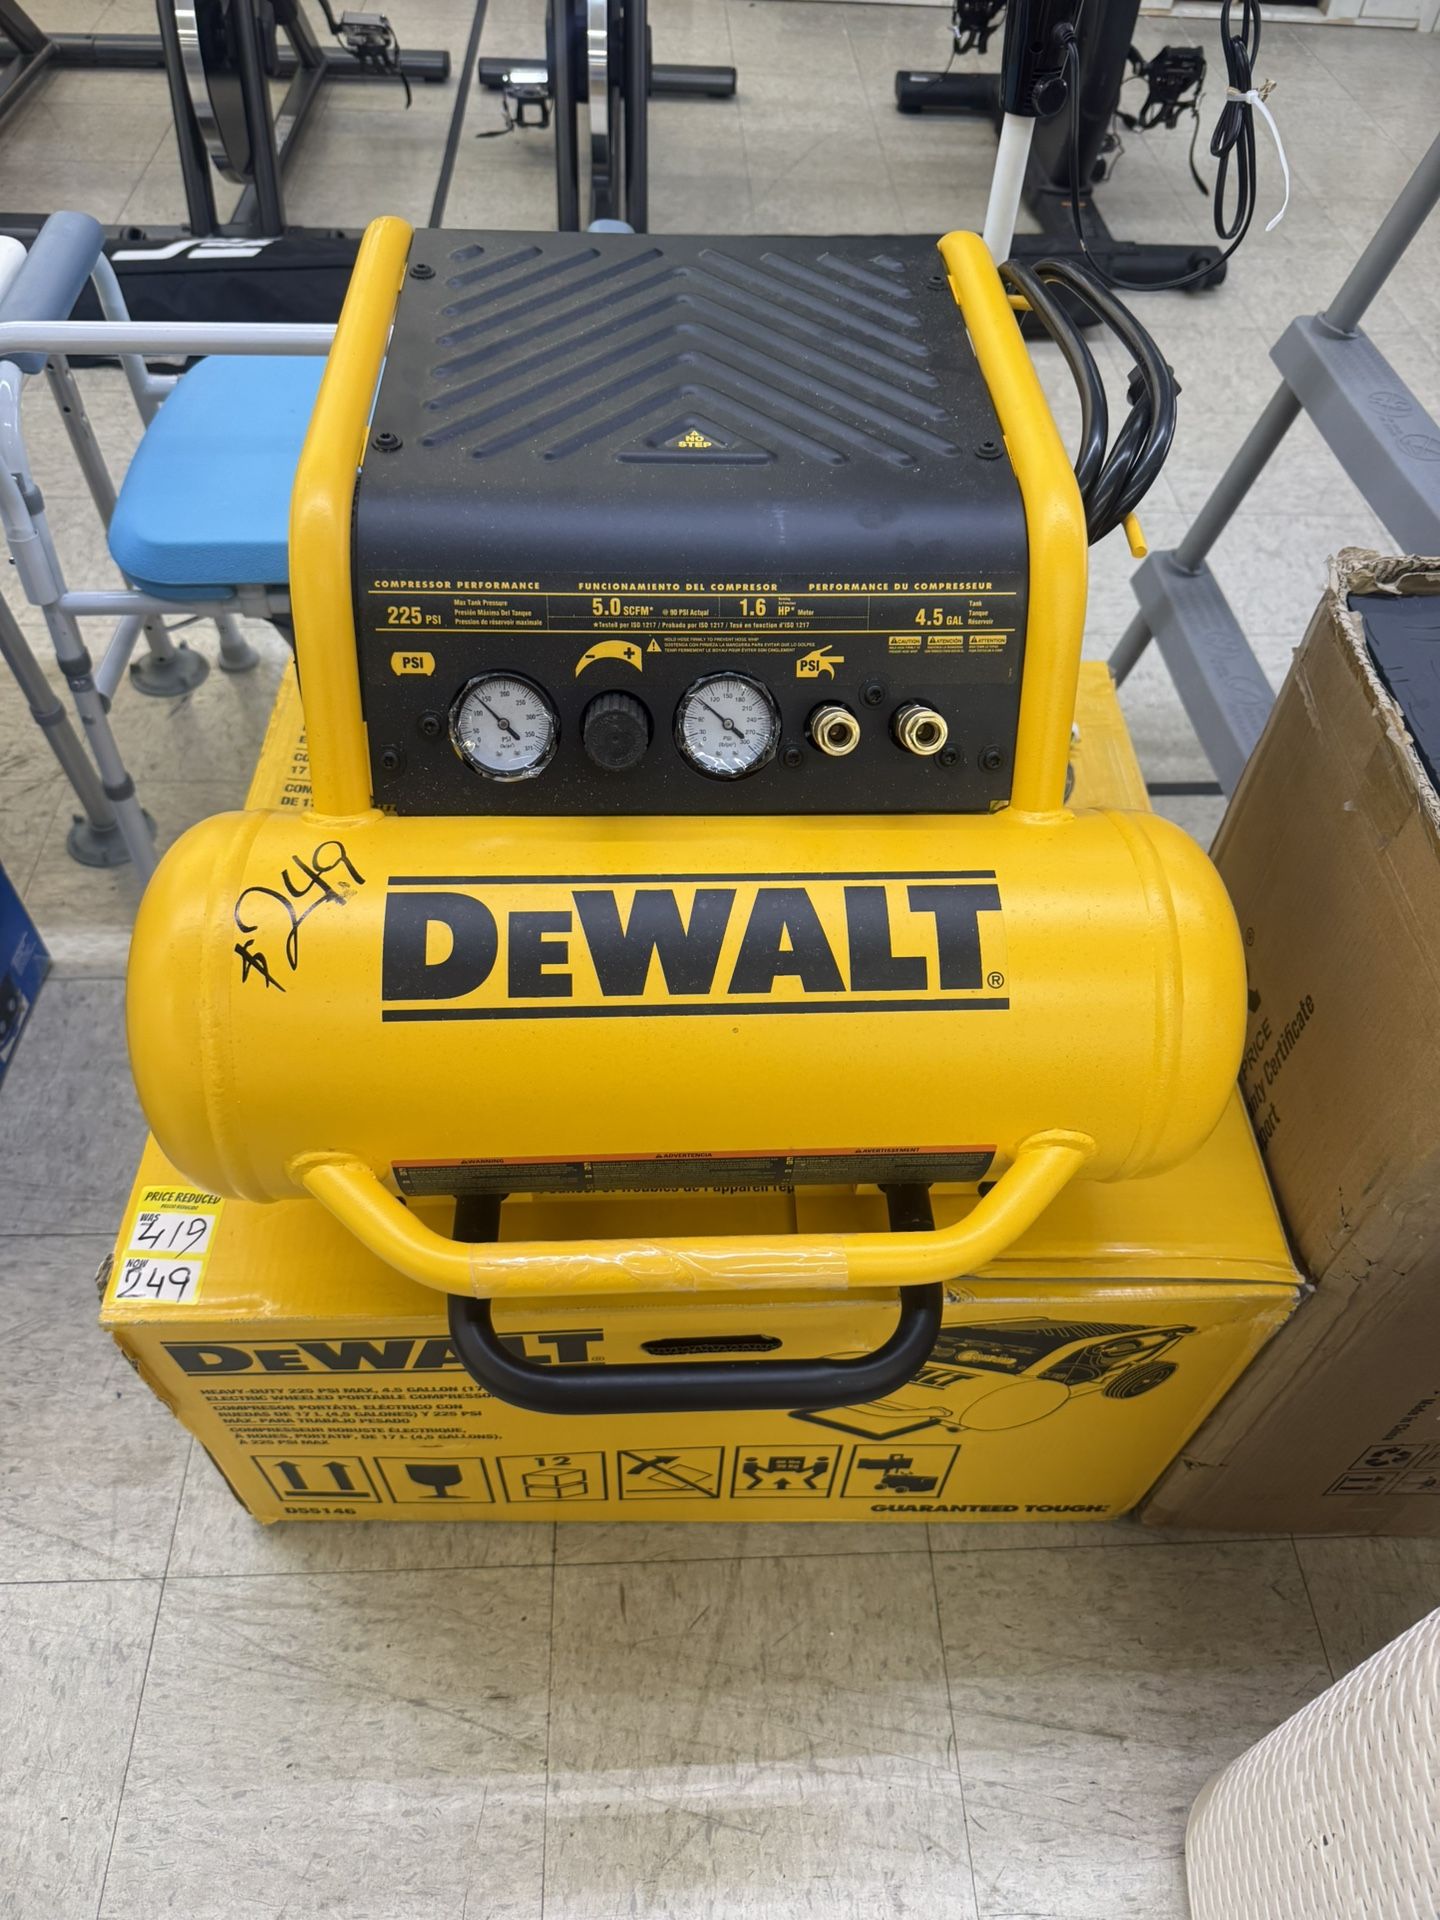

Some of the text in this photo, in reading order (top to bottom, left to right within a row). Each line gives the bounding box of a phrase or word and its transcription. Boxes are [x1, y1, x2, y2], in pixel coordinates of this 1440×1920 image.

[374, 580, 540, 590] COMPRESSOR PERFORMANCE
[578, 582, 778, 591] FUNCIONAMIENTO DEL COMPRESOR
[808, 582, 993, 591] PERFORMANCE DU COMPRESSEUR
[592, 597, 621, 616] 5.0
[740, 598, 767, 616] 1.6
[387, 606, 442, 625] 225 PSI
[511, 609, 532, 617] Tanque
[915, 607, 964, 626] 4.5 GAL
[968, 609, 989, 618] Tanque
[402, 656, 424, 669] PSI
[800, 660, 820, 671] PSI
[292, 766, 307, 774] 17
[281, 796, 298, 806] DE
[1263, 994, 1316, 1086] Certificate
[1240, 1017, 1273, 1080] PRICE
[145, 1191, 221, 1205] PRICE REDUCED
[139, 1213, 161, 1222] WAS
[138, 1217, 207, 1259] 419
[126, 1258, 149, 1268] NOW
[116, 1266, 191, 1303] 249
[870, 1503, 1019, 1512] GUARANTEED
